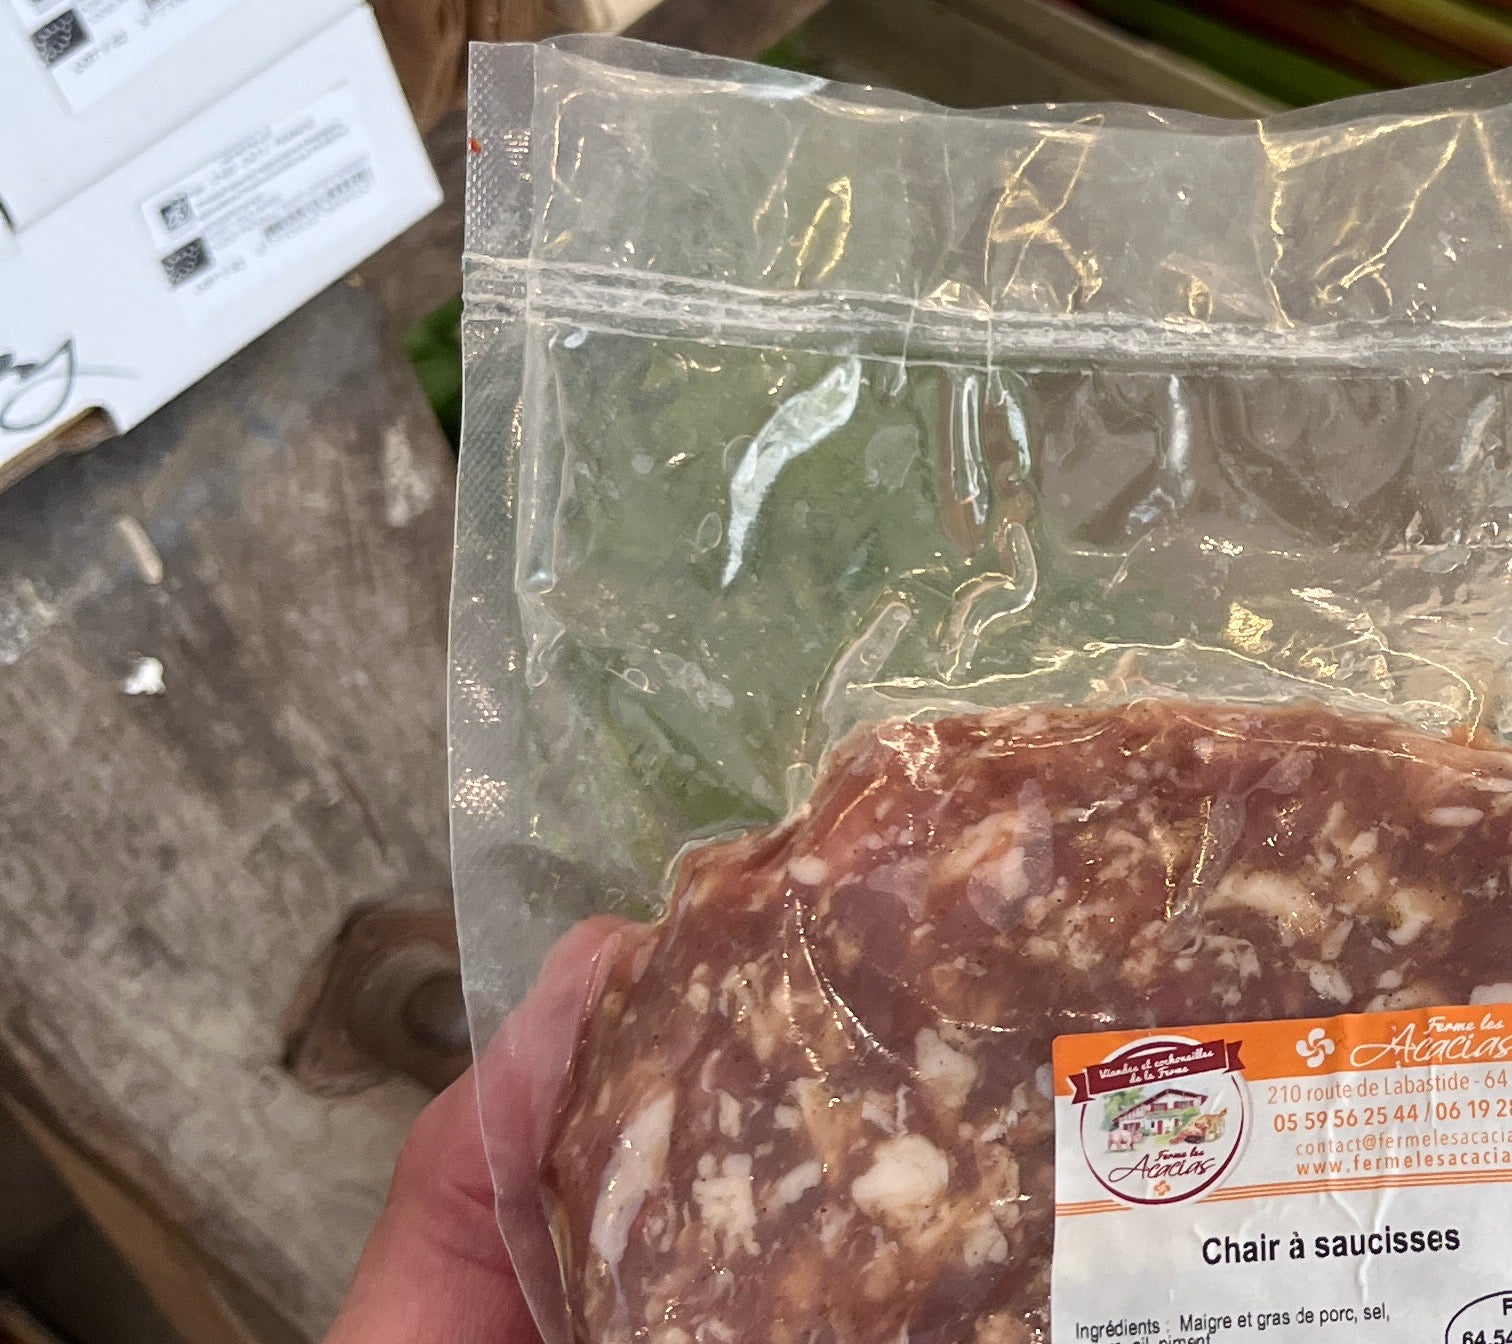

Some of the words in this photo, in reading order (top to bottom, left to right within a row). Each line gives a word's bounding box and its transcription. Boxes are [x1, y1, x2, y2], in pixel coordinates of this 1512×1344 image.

[1423, 1015, 1476, 1035] Ferme
[1480, 1013, 1505, 1030] les
[1099, 1064, 1139, 1080] Viandes
[1141, 1059, 1153, 1073] et
[1129, 1071, 1141, 1084] de
[1143, 1068, 1157, 1082] la
[1158, 1065, 1189, 1081] Ferme
[1267, 1083, 1301, 1105] 210
[1307, 1080, 1351, 1102] route
[1357, 1076, 1378, 1097] de
[1384, 1070, 1469, 1096] Labastide
[1273, 1113, 1298, 1134] 05
[1304, 1110, 1328, 1131] 59
[1333, 1108, 1358, 1129] 56
[1363, 1106, 1388, 1126] 25
[1394, 1103, 1419, 1123] 44
[1436, 1100, 1461, 1121] 06
[1468, 1099, 1490, 1120] 19
[1108, 1154, 1217, 1182] Acacias
[1154, 1148, 1187, 1163] Ferme
[1189, 1145, 1205, 1158] les
[1202, 1232, 1280, 1265] Chair
[1289, 1231, 1305, 1259] à
[1314, 1224, 1461, 1257] saucisses
[1075, 1317, 1161, 1343] Ingrédients
[1180, 1312, 1232, 1336] Maigre
[1237, 1310, 1253, 1328] et
[1257, 1310, 1291, 1331] gras
[1295, 1307, 1314, 1325] de
[1319, 1305, 1358, 1327] porc,
[1363, 1302, 1390, 1323] sel,
